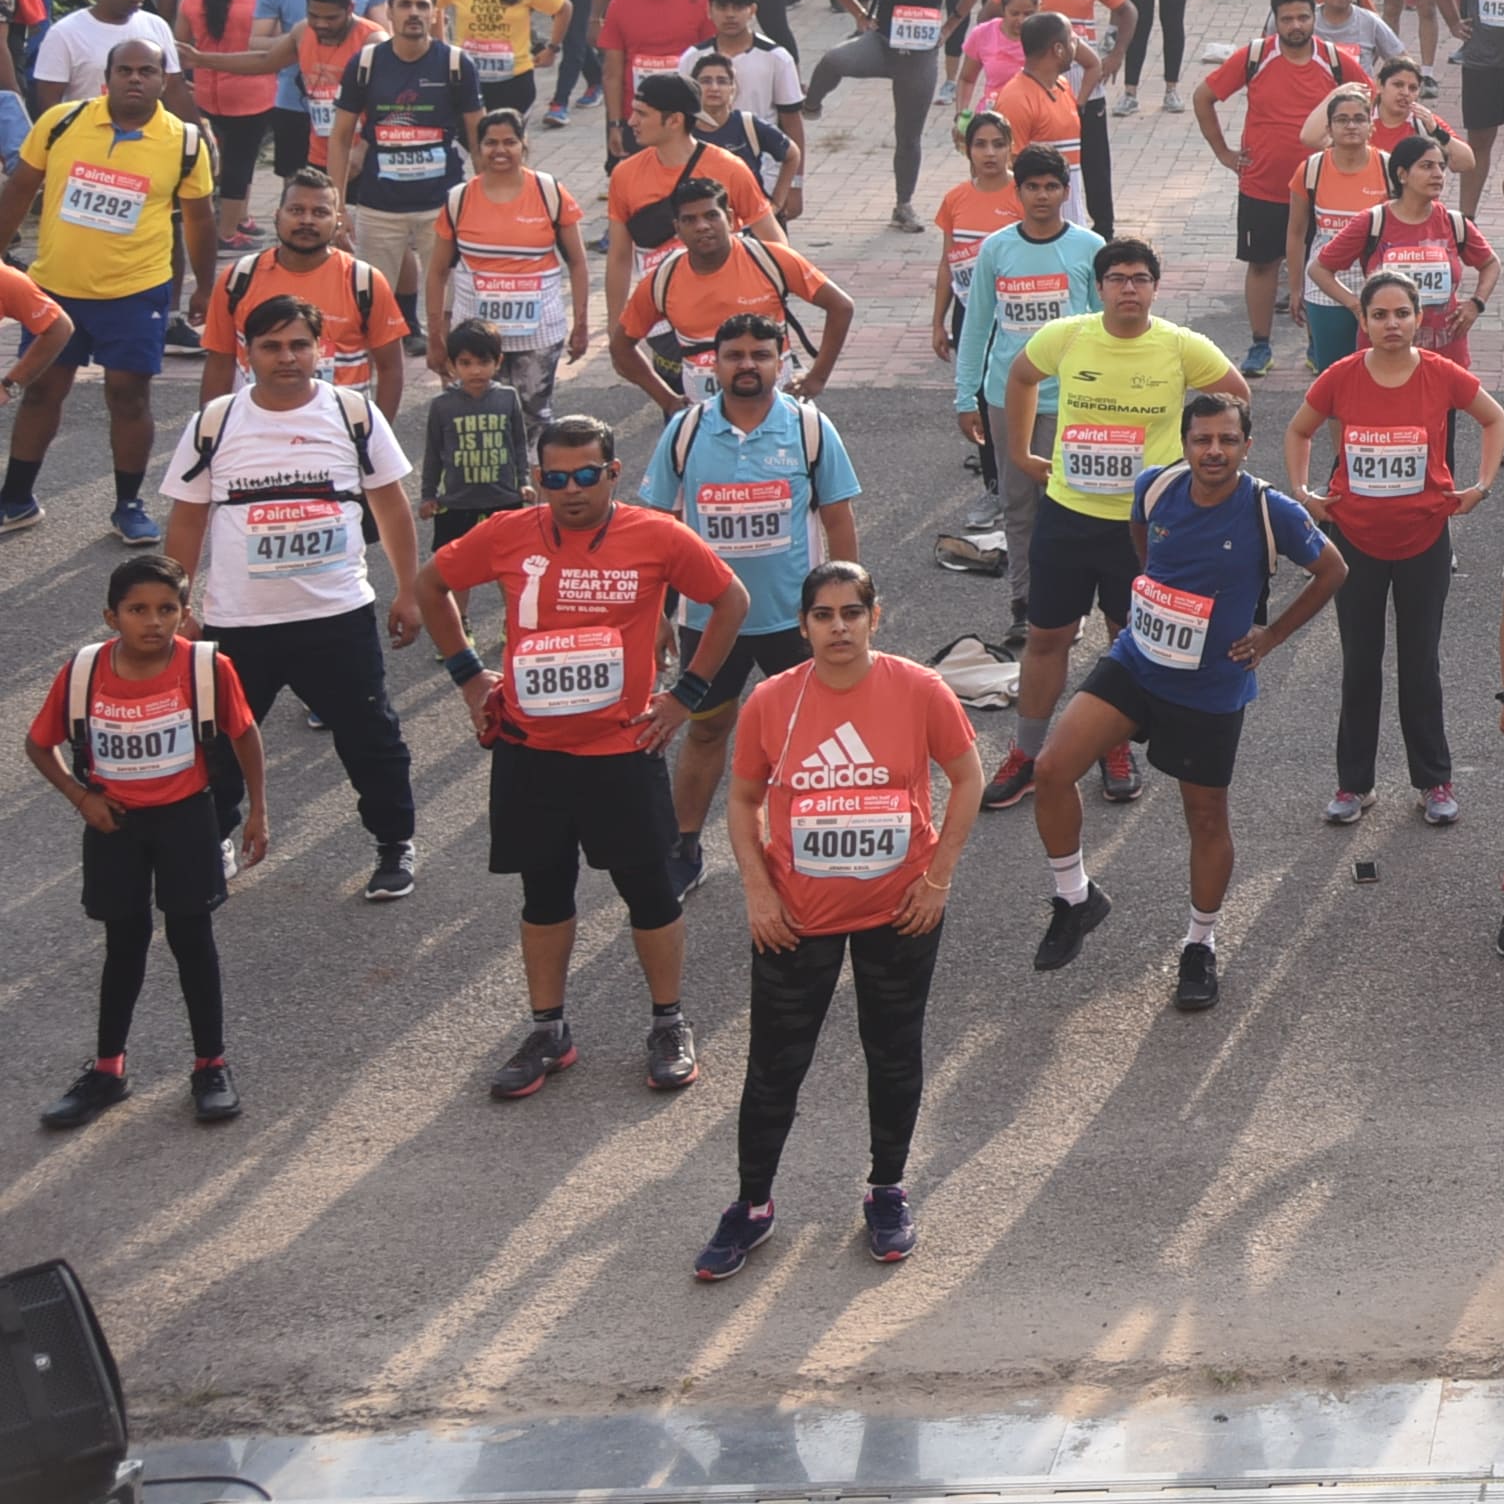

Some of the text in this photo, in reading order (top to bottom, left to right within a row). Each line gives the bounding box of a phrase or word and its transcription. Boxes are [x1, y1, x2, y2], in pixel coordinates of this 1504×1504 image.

[388, 127, 416, 141] airtel
[85, 167, 116, 186] airtel
[69, 183, 133, 219] 41292
[1397, 250, 1425, 262] airtel
[486, 278, 516, 291] airtel
[1006, 279, 1036, 293] airtel
[478, 301, 535, 320] 48070
[1003, 301, 1061, 323] 42559
[1067, 399, 1167, 415] PERFORMANCE
[453, 415, 507, 432] THERE
[458, 432, 503, 449] IS NO
[1077, 428, 1108, 442] airtel
[1360, 430, 1392, 444] airtel
[454, 449, 508, 467] FINISH
[1069, 453, 1134, 479] 39588
[464, 466, 500, 484] LINE
[1352, 455, 1418, 481] 42143
[714, 487, 751, 502] airtel
[264, 505, 305, 522] airtel
[707, 510, 781, 541] 50159
[257, 528, 334, 561] 47427
[560, 568, 639, 581] WEAR YOUR
[557, 579, 638, 593] HEART ON
[1145, 581, 1173, 605] airtel
[557, 590, 637, 602] YOUR SLEEVE
[1134, 614, 1193, 652] 39910
[535, 634, 576, 652] airtel
[525, 662, 611, 696] 38688
[104, 704, 142, 719] airtel
[97, 727, 177, 761] 38807
[791, 762, 891, 791] adidas
[815, 795, 862, 811] airtel
[803, 828, 895, 858] 40054
